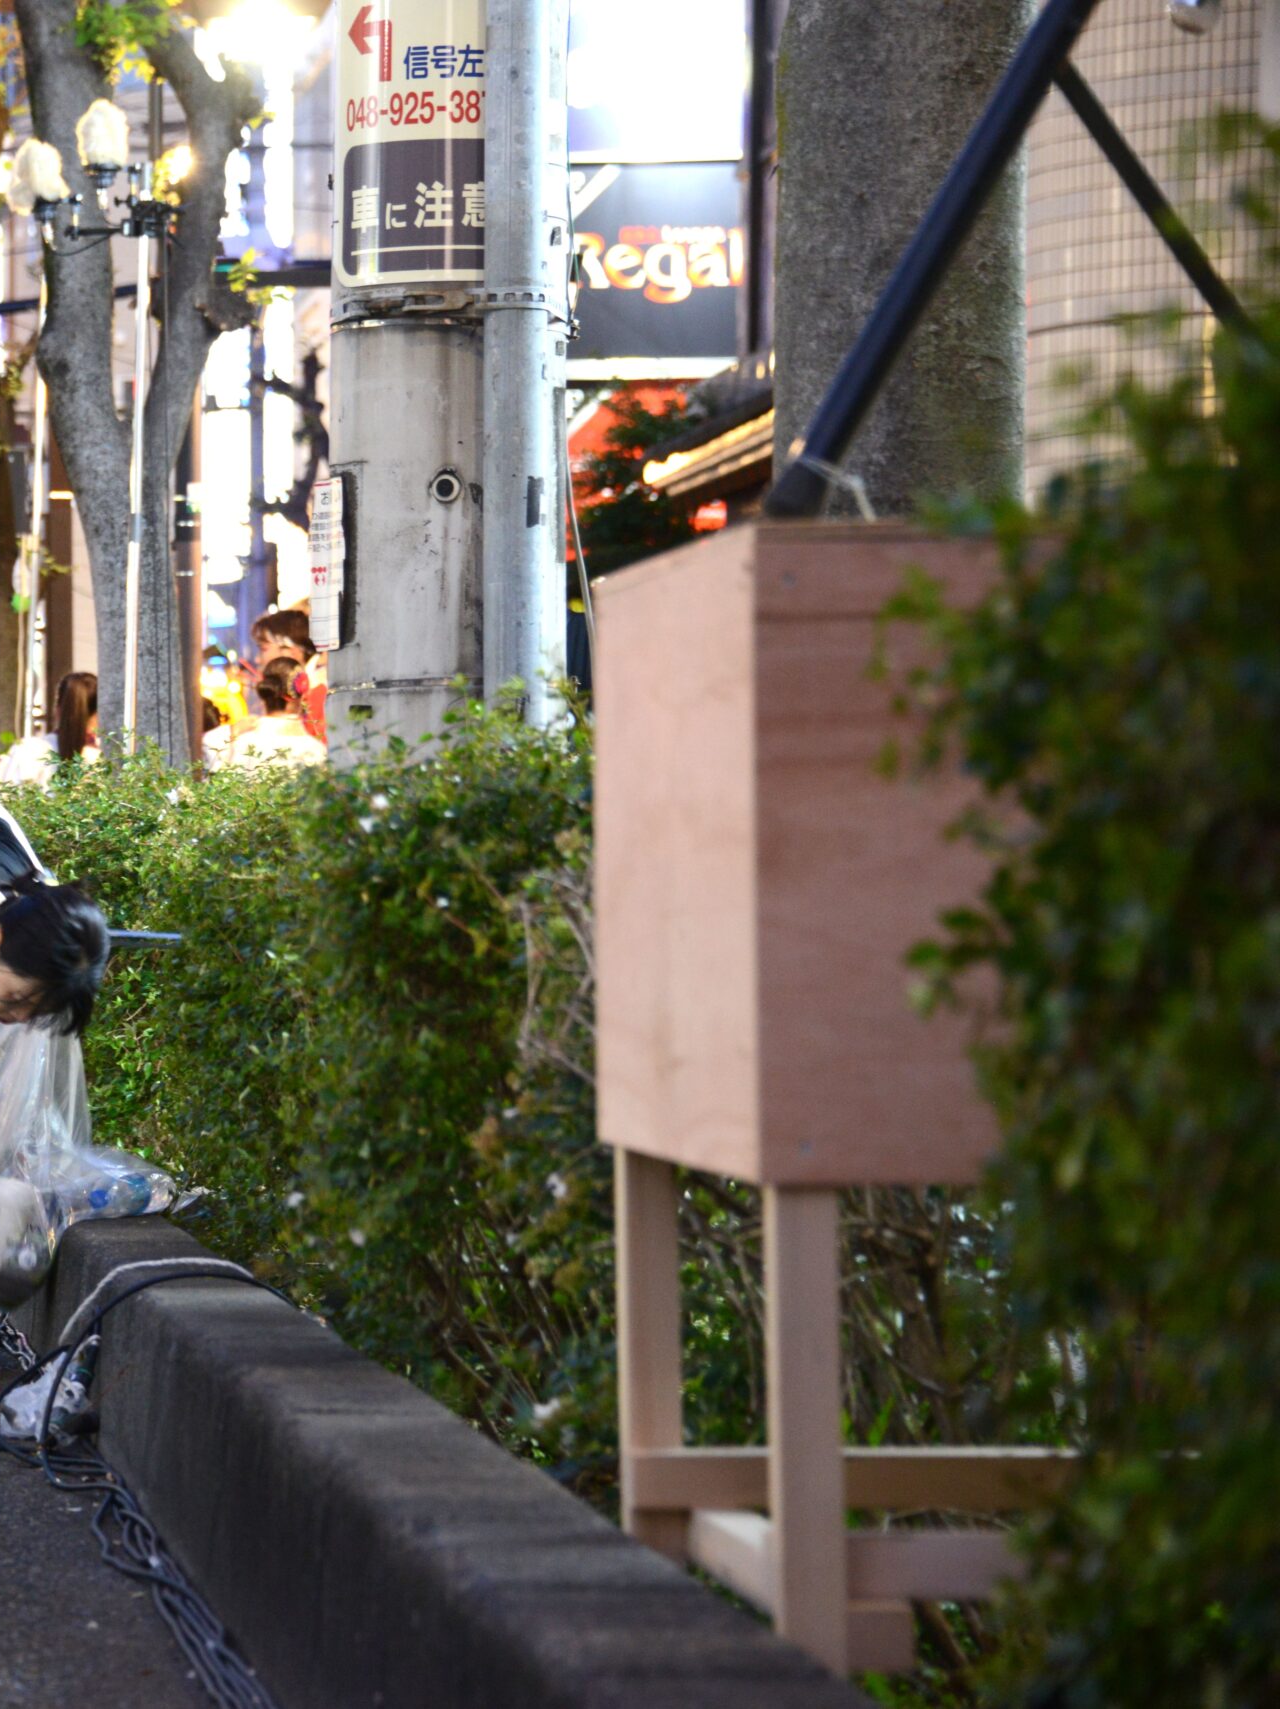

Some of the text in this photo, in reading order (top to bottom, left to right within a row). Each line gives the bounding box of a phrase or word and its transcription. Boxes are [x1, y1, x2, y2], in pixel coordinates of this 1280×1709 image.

[403, 44, 485, 80] 信号左
[346, 90, 486, 132] 048-925-38
[350, 180, 485, 234] 車に注意
